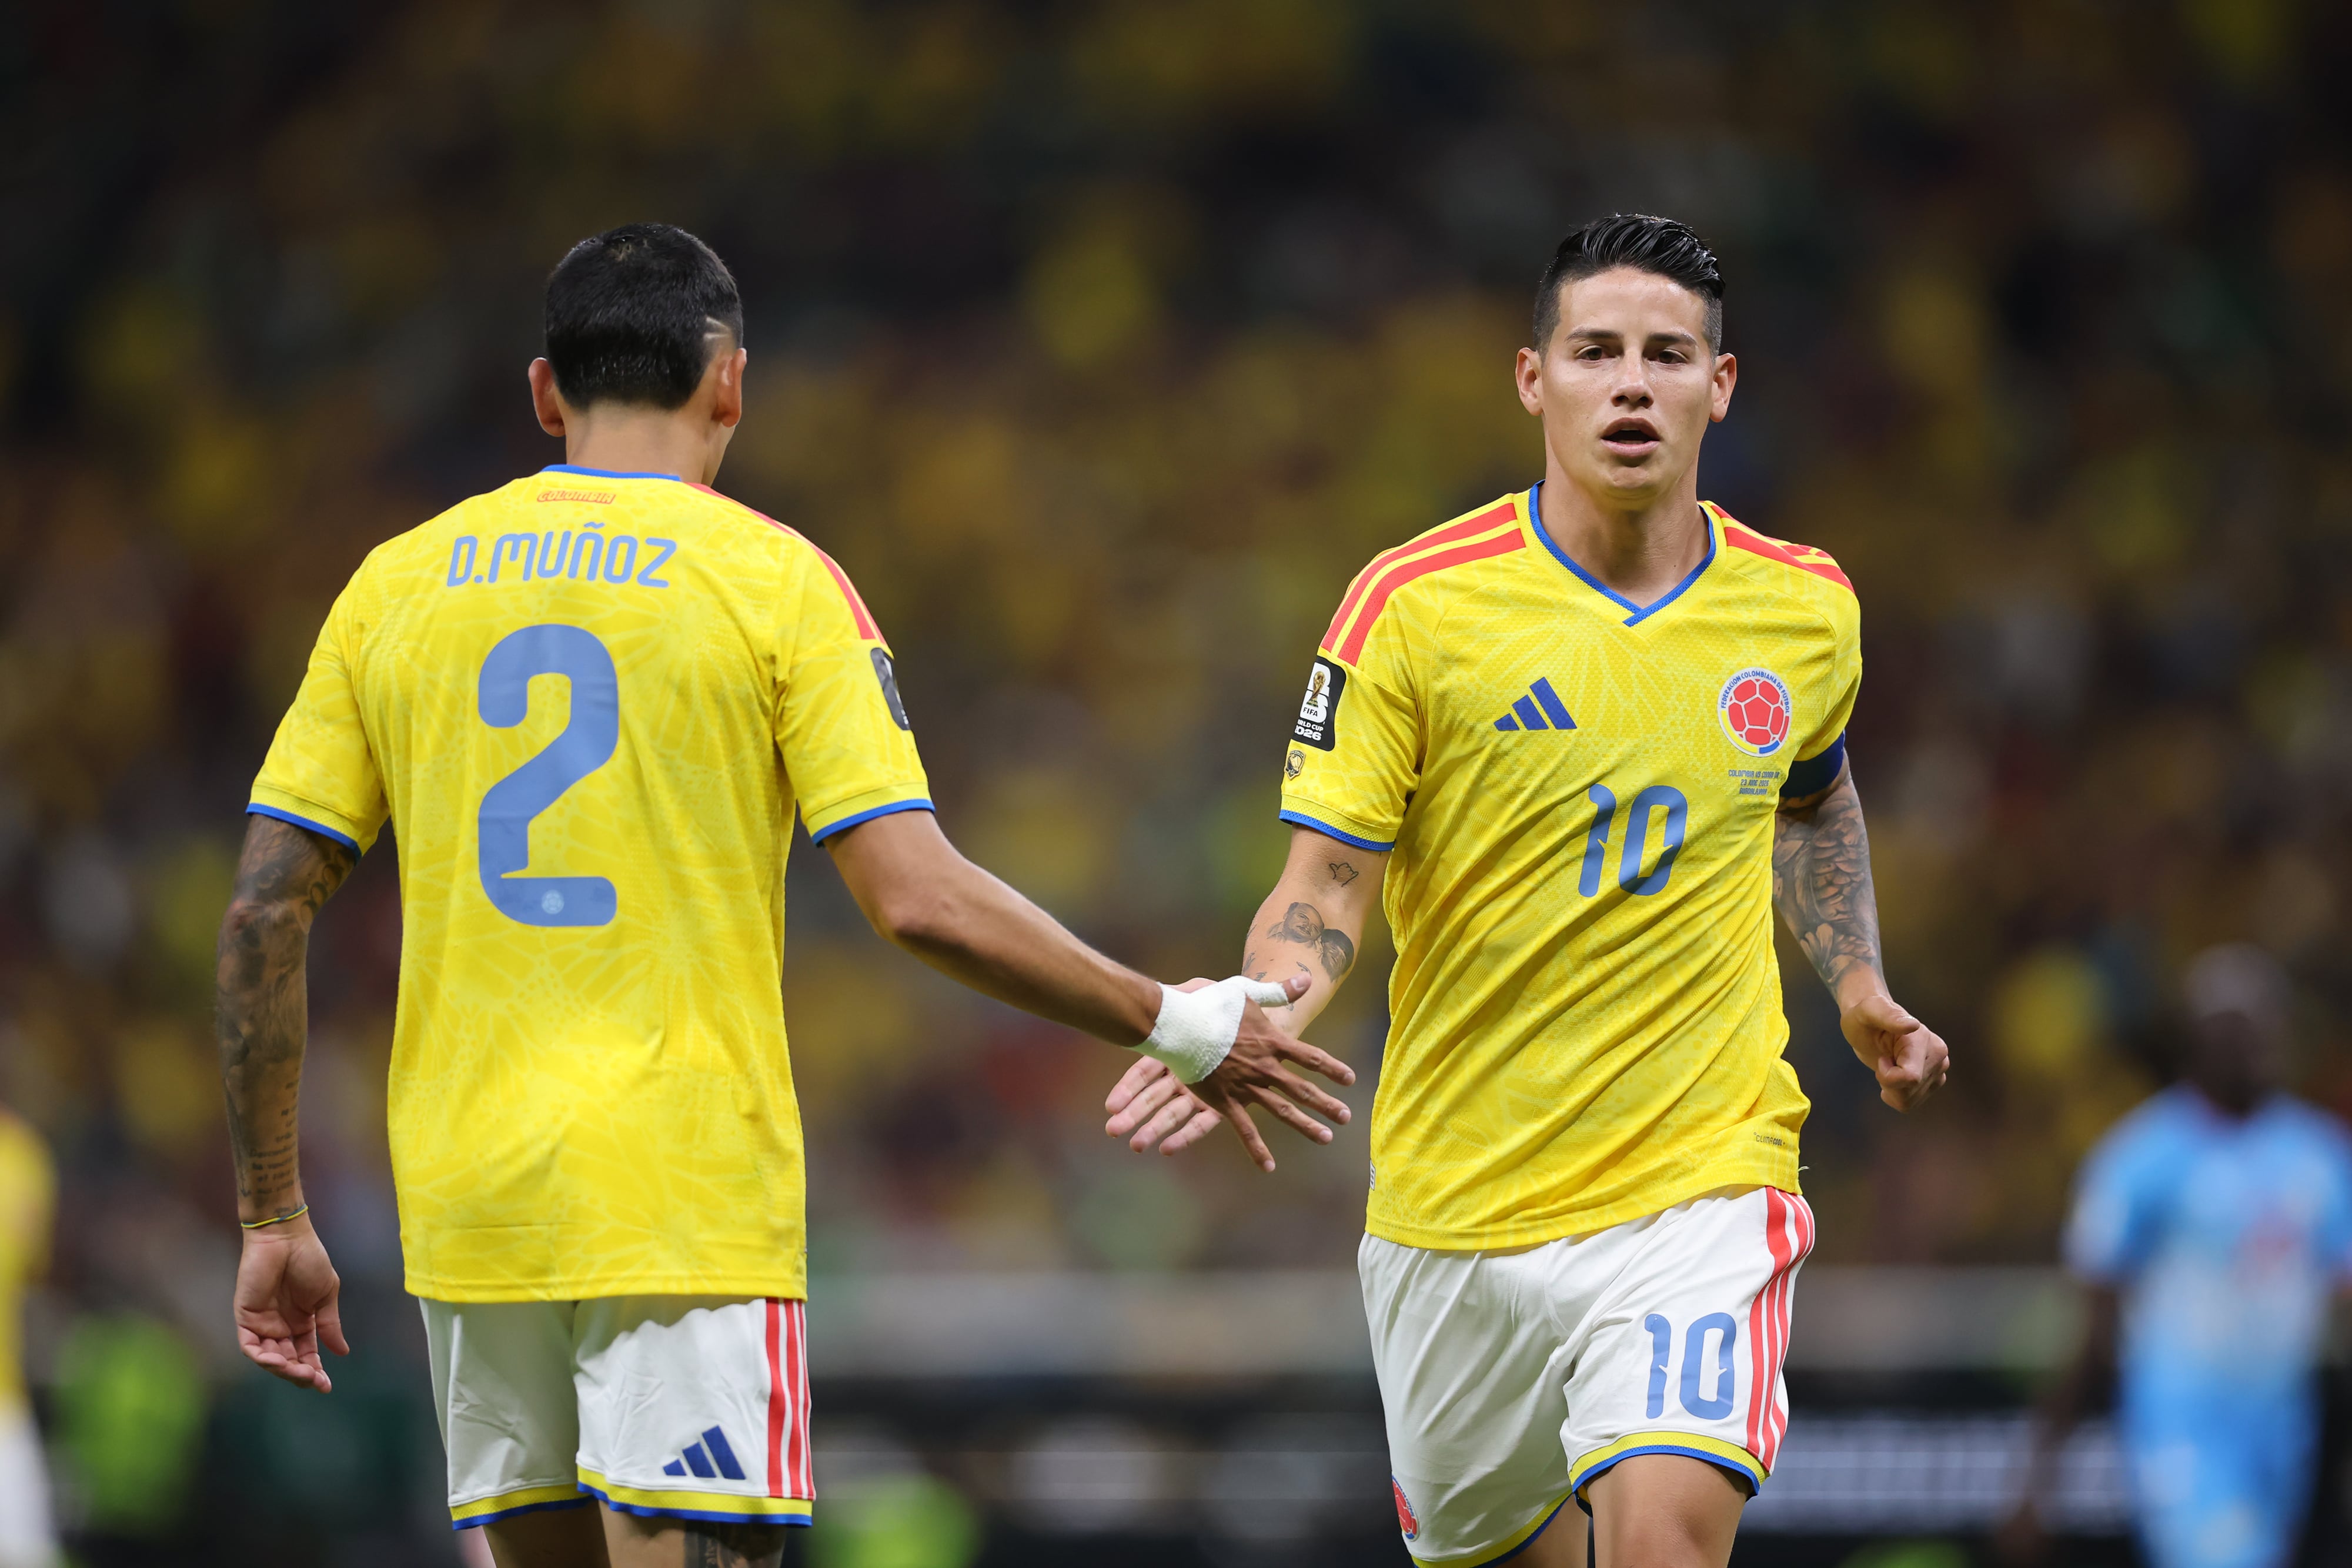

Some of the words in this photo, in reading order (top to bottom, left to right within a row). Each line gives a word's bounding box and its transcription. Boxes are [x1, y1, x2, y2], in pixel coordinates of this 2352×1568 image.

[537, 490, 616, 504] COLOMBIA
[447, 521, 677, 588] D.MUÑOZ
[1303, 707, 1318, 717] FIFA
[1721, 676, 1741, 708] FEDERACION
[1741, 670, 1777, 684] COLOMBIANA
[1776, 682, 1783, 690] DE
[1781, 690, 1789, 713] FUTBOL
[478, 623, 619, 927] 2
[1729, 770, 1754, 778] COLOMBIA
[1578, 784, 1688, 897] 10
[1644, 1312, 1736, 1420] 10
